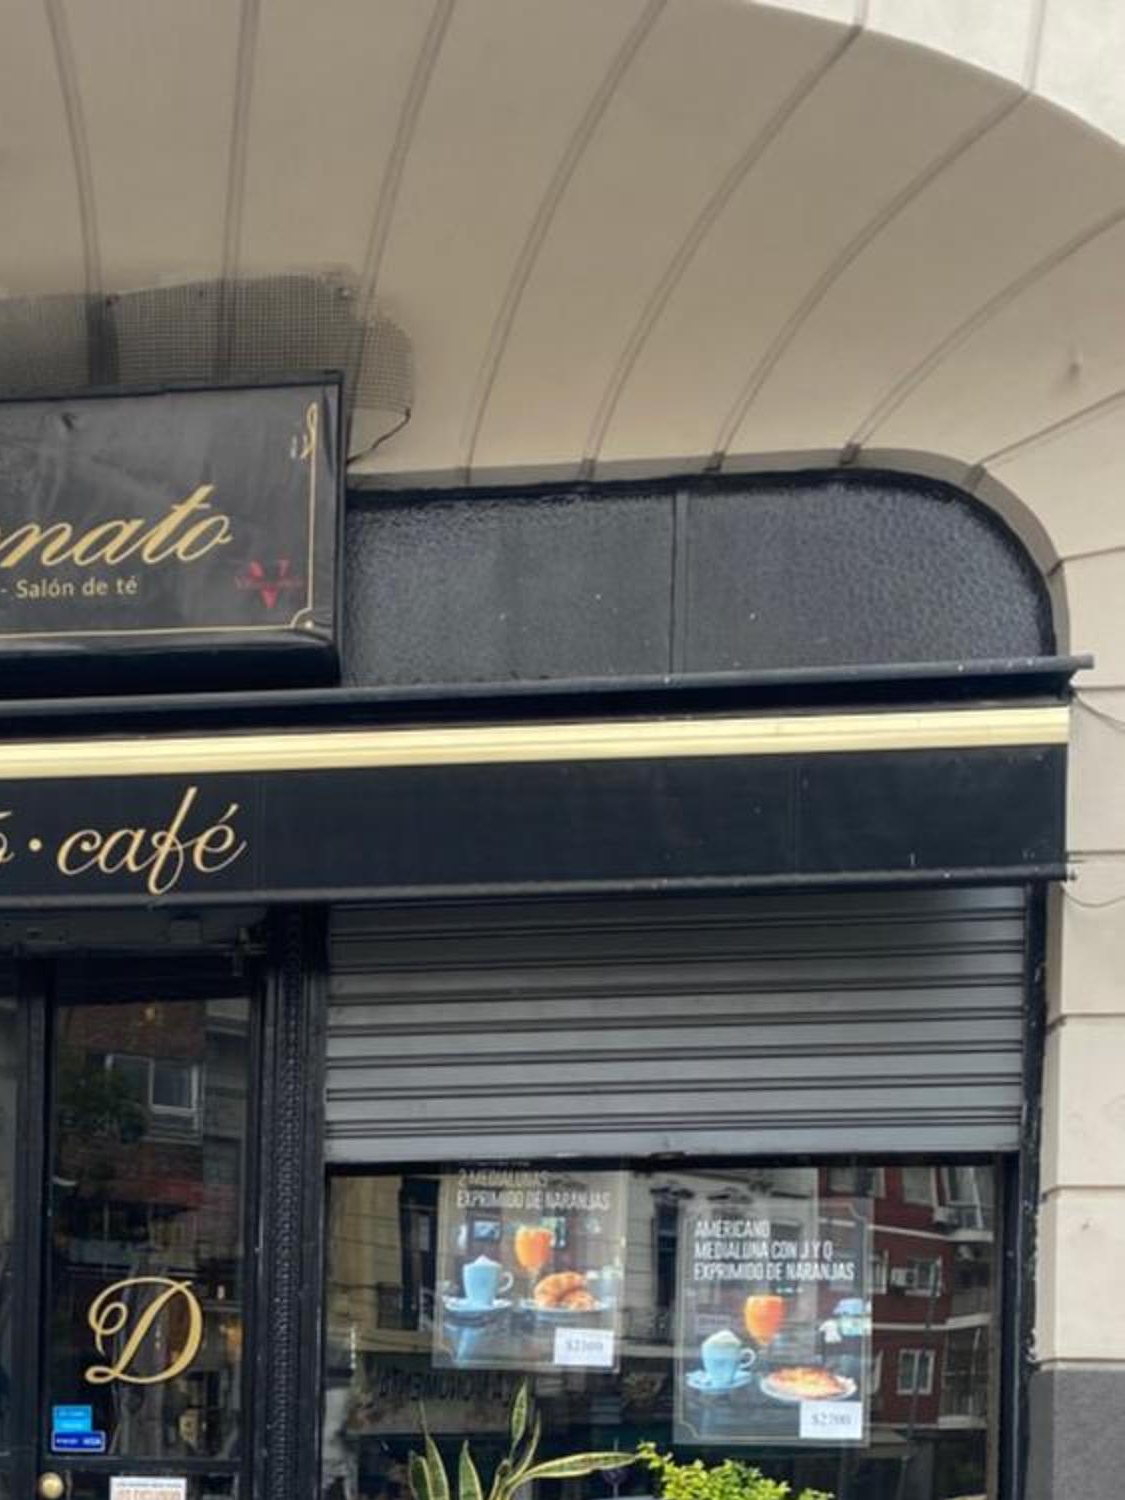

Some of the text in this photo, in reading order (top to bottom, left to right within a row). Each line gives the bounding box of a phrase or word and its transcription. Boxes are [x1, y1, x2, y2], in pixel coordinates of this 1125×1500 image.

[15, 577, 75, 600] Salón
[81, 576, 109, 597] de
[115, 574, 140, 596] té
[56, 786, 248, 896] café
[525, 1190, 542, 1210] DE
[544, 1191, 612, 1211] NARANJAS
[694, 1219, 771, 1239] AMERICANO
[771, 1240, 798, 1260] CON
[694, 1261, 855, 1281] EXPRIMIDO DE NARANJAS
[84, 1276, 203, 1384] D
